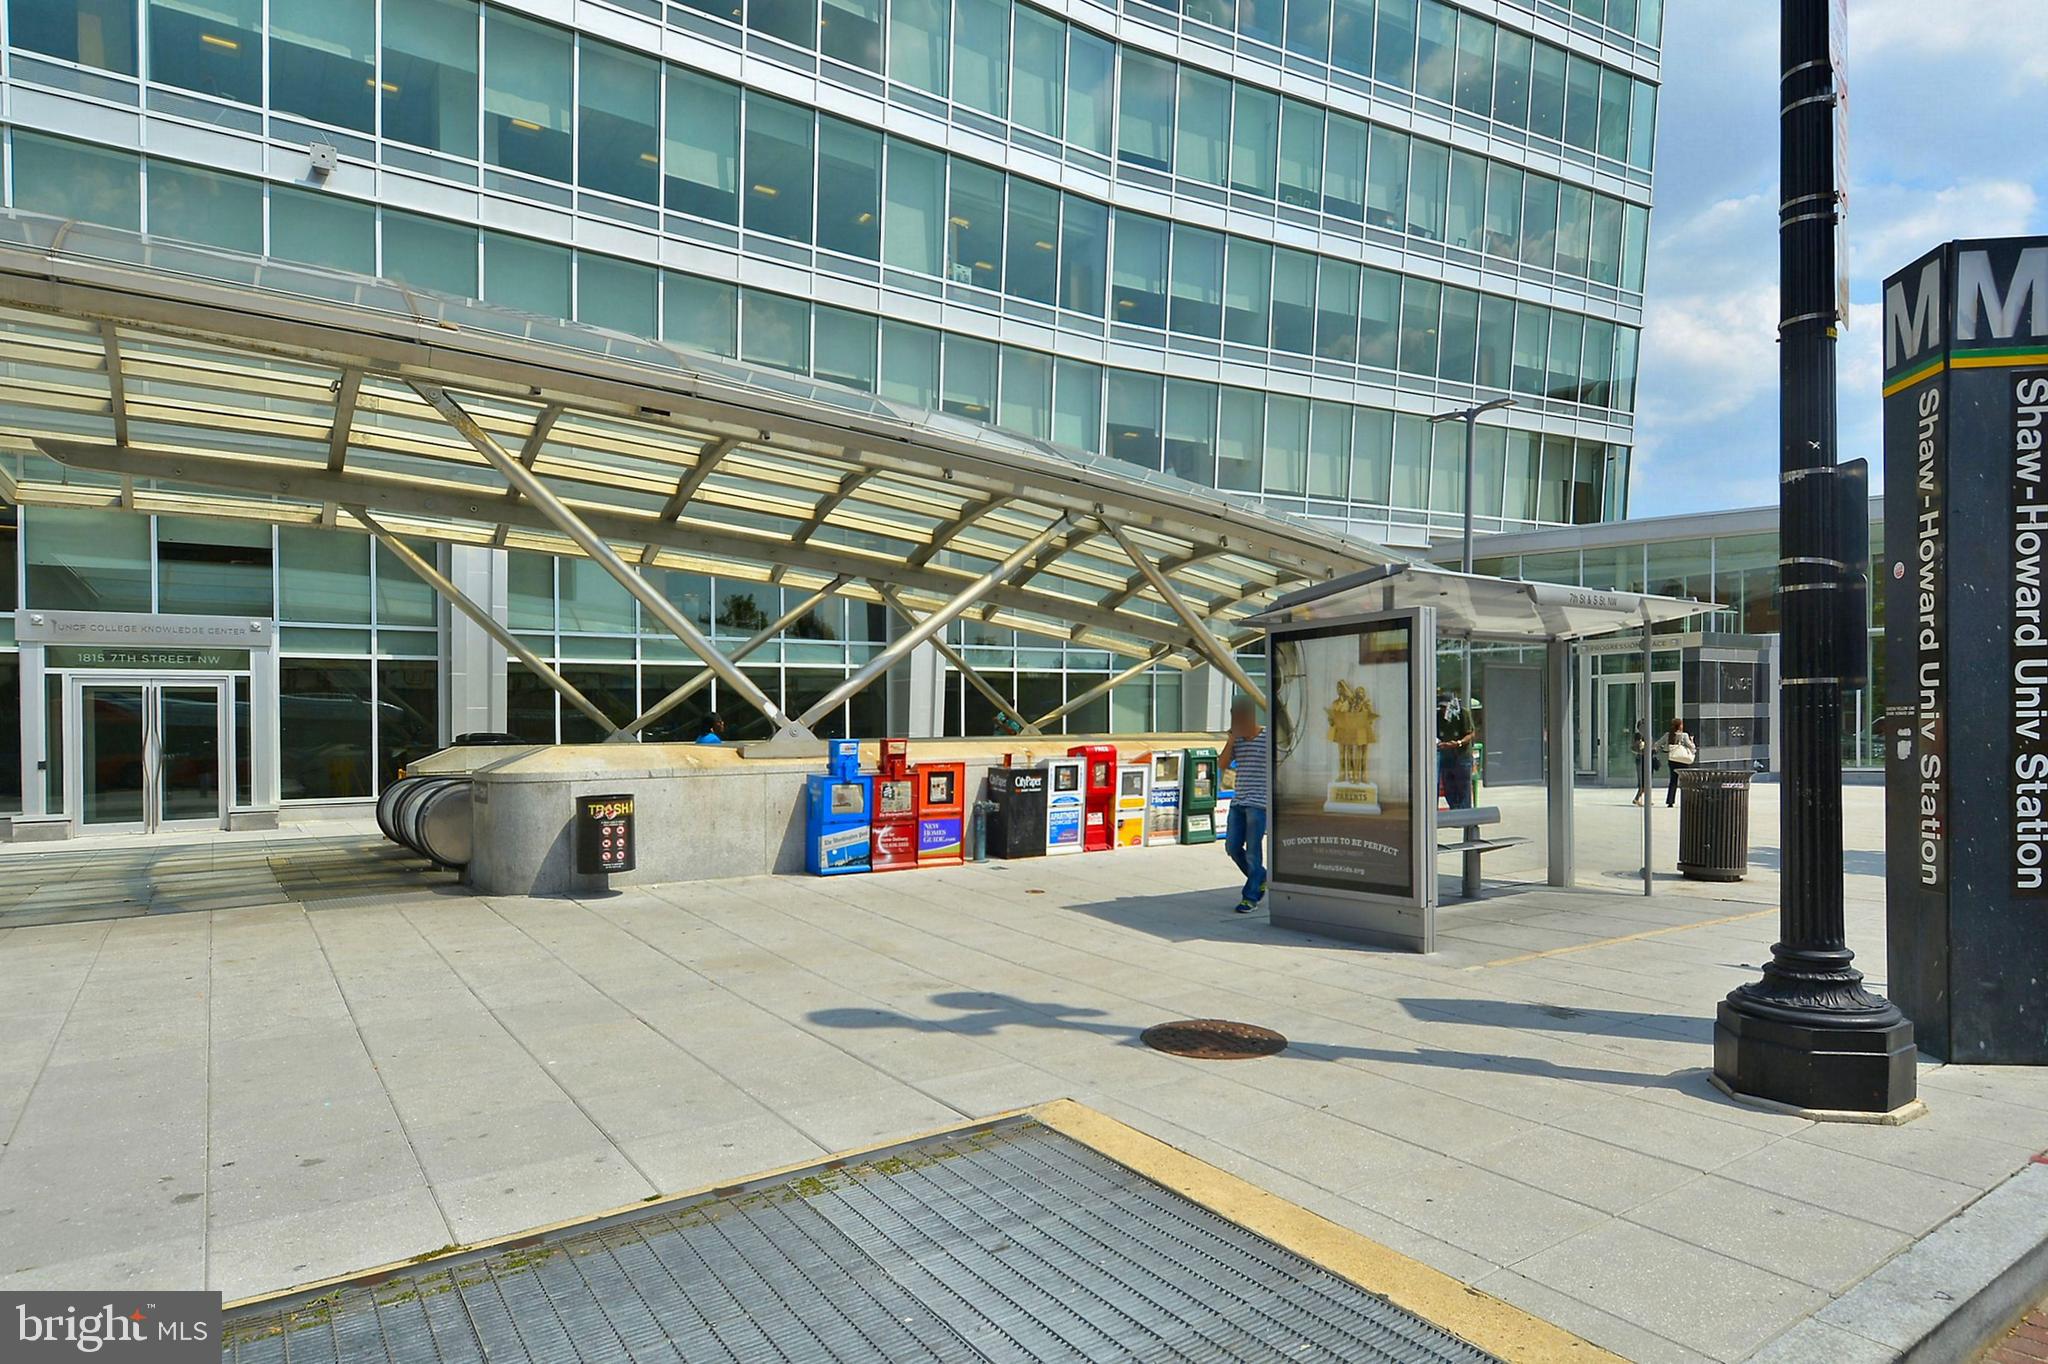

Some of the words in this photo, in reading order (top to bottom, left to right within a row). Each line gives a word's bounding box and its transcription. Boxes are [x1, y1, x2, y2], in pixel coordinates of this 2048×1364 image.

[1886, 258, 1940, 370] M
[1957, 247, 2048, 340] M
[57, 623, 86, 632] UNCF
[91, 624, 137, 633] COLLEGE
[141, 625, 203, 635] KNOWLEDGE
[208, 627, 245, 636] CENTER
[78, 653, 105, 663] 1815
[110, 653, 136, 663] 7TH
[142, 654, 192, 664] STREET
[198, 655, 221, 665] NW
[1919, 662, 1940, 741] Univ
[2014, 659, 2048, 741] Univ
[1282, 838, 1296, 847] YOU
[1320, 836, 1339, 845] HAVE
[1340, 837, 1350, 845] TO
[1351, 838, 1362, 847] BE
[1363, 840, 1399, 856] PERFECT
[1920, 754, 1941, 885] Station
[2015, 754, 2048, 889] Station
